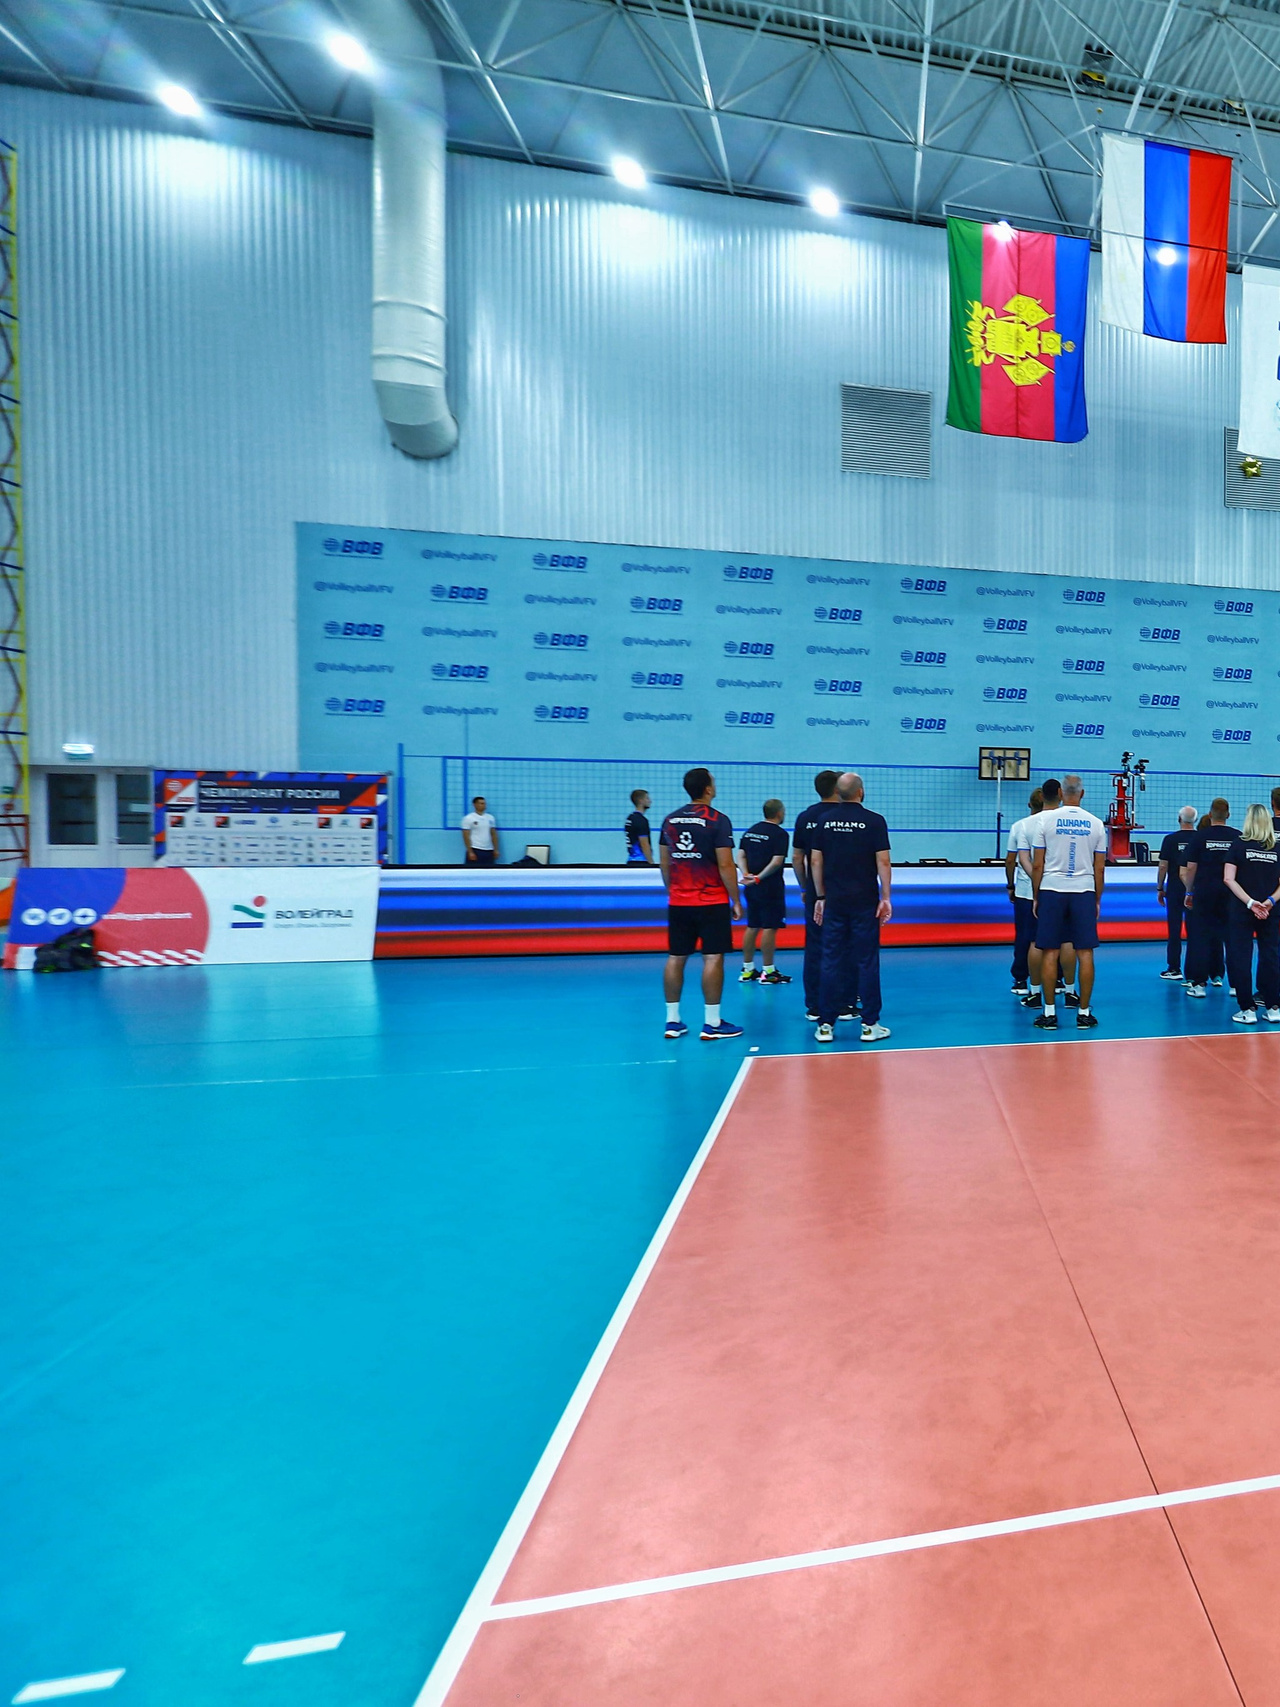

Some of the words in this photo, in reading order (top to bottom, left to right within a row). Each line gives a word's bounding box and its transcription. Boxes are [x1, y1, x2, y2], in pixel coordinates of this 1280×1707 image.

[340, 539, 384, 556] ВФВ
[547, 554, 589, 570] ВФВ
[737, 566, 775, 581] ВФВ
[446, 585, 489, 601] ВФВ
[913, 578, 948, 593] ВФВ
[1074, 589, 1106, 604] ВФВ
[645, 597, 684, 612] ВФВ
[1225, 600, 1254, 614] ВФВ
[828, 607, 863, 622] ВФВ
[340, 621, 385, 638] ВФВ
[995, 618, 1028, 632] ВФВ
[548, 632, 589, 648] ВФВ
[1151, 627, 1181, 641] ВФВ
[738, 641, 775, 656] ВФВ
[913, 650, 947, 665] ВФВ
[446, 664, 490, 679] ВФВ
[1074, 659, 1106, 673] ВФВ
[1223, 667, 1253, 680] ВФВ
[646, 672, 684, 687] ВФВ
[827, 679, 863, 694] ВФВ
[995, 687, 1028, 701] ВФВ
[1150, 694, 1181, 707] ВФВ
[341, 698, 386, 714] ВФВ
[548, 705, 590, 720] ВФВ
[738, 711, 776, 726] ВФВ
[913, 717, 947, 731] ВФВ
[1074, 723, 1105, 736] ВФВ
[1223, 729, 1252, 742] ВФВ
[200, 788, 284, 798] ЧЕМПИОНАТ
[287, 789, 340, 799] РОССИИ
[824, 821, 866, 829] ДИНАМО
[1056, 819, 1092, 829] ДИНАМО
[275, 909, 353, 920] ВОЛЕЙГРАД
